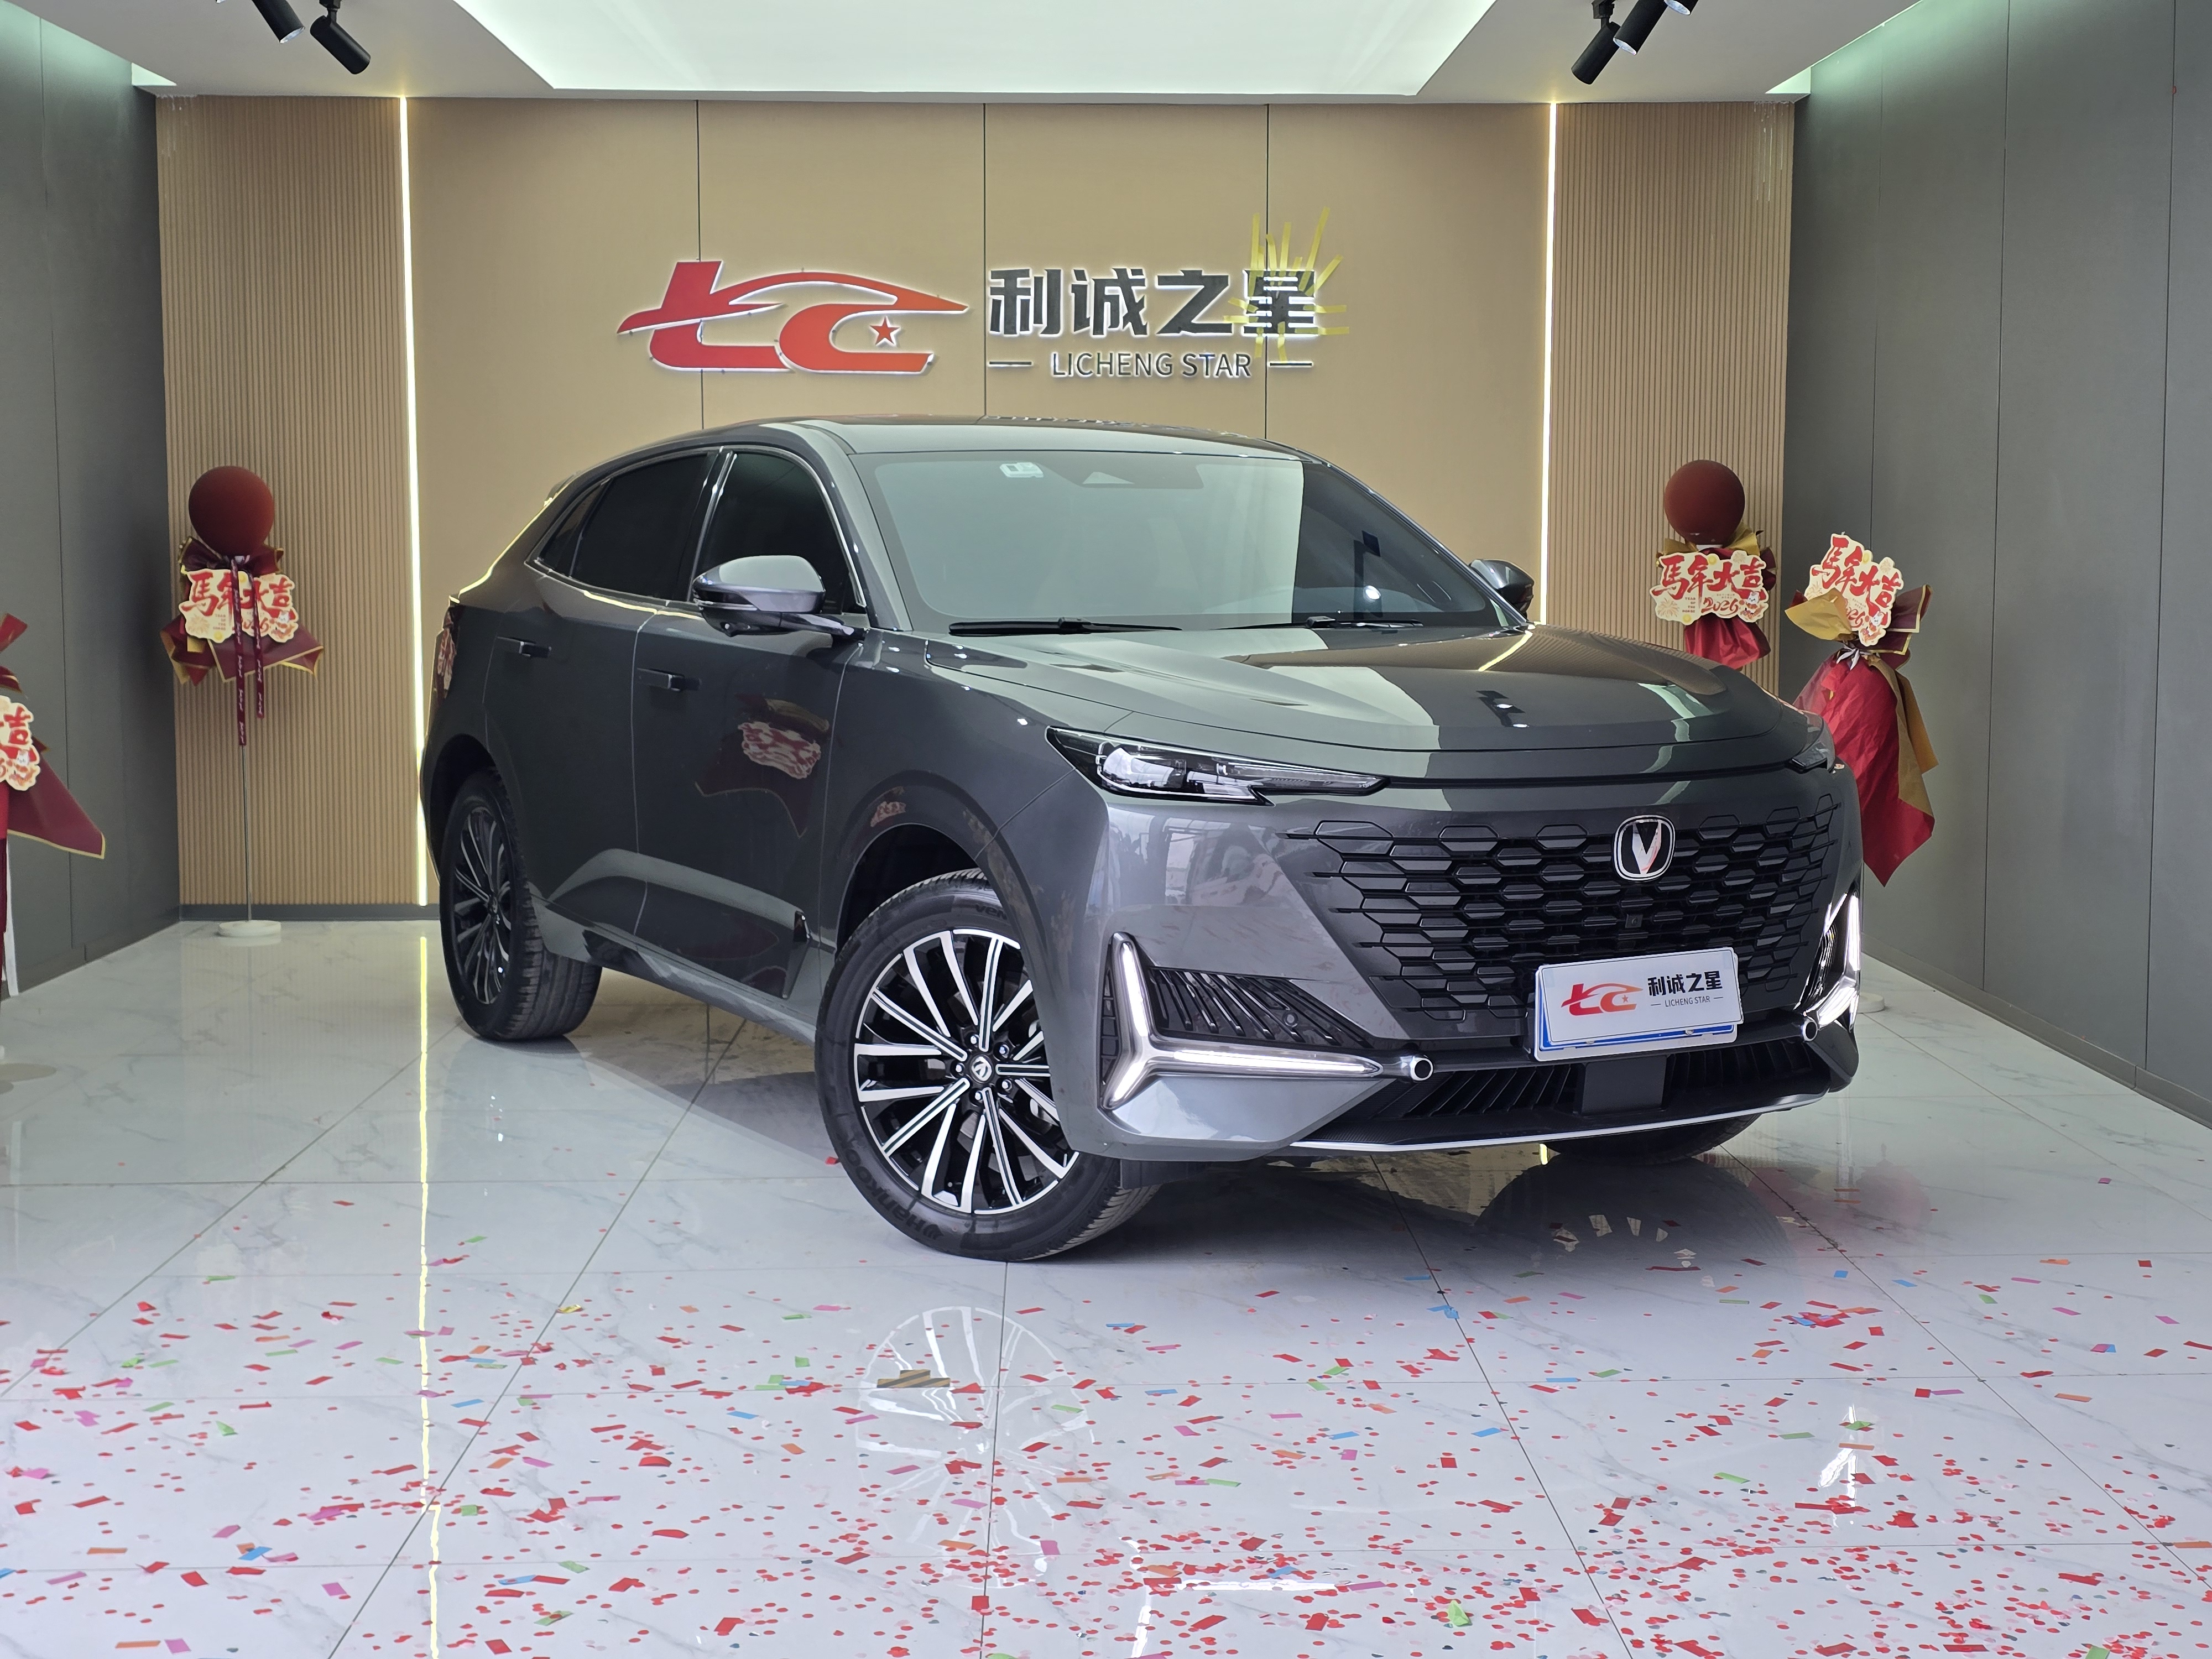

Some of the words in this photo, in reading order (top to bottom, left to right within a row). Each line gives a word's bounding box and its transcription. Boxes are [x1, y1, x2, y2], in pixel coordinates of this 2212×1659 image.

[989, 268, 1315, 335] 利诚之星
[1052, 353, 1173, 377] LICHENG
[1182, 353, 1251, 377] STAR
[1701, 597, 1739, 616] 2026
[1647, 971, 1723, 996] 利诚之星
[1665, 998, 1693, 1007] LICHENG
[1694, 995, 1710, 1004] STAR
